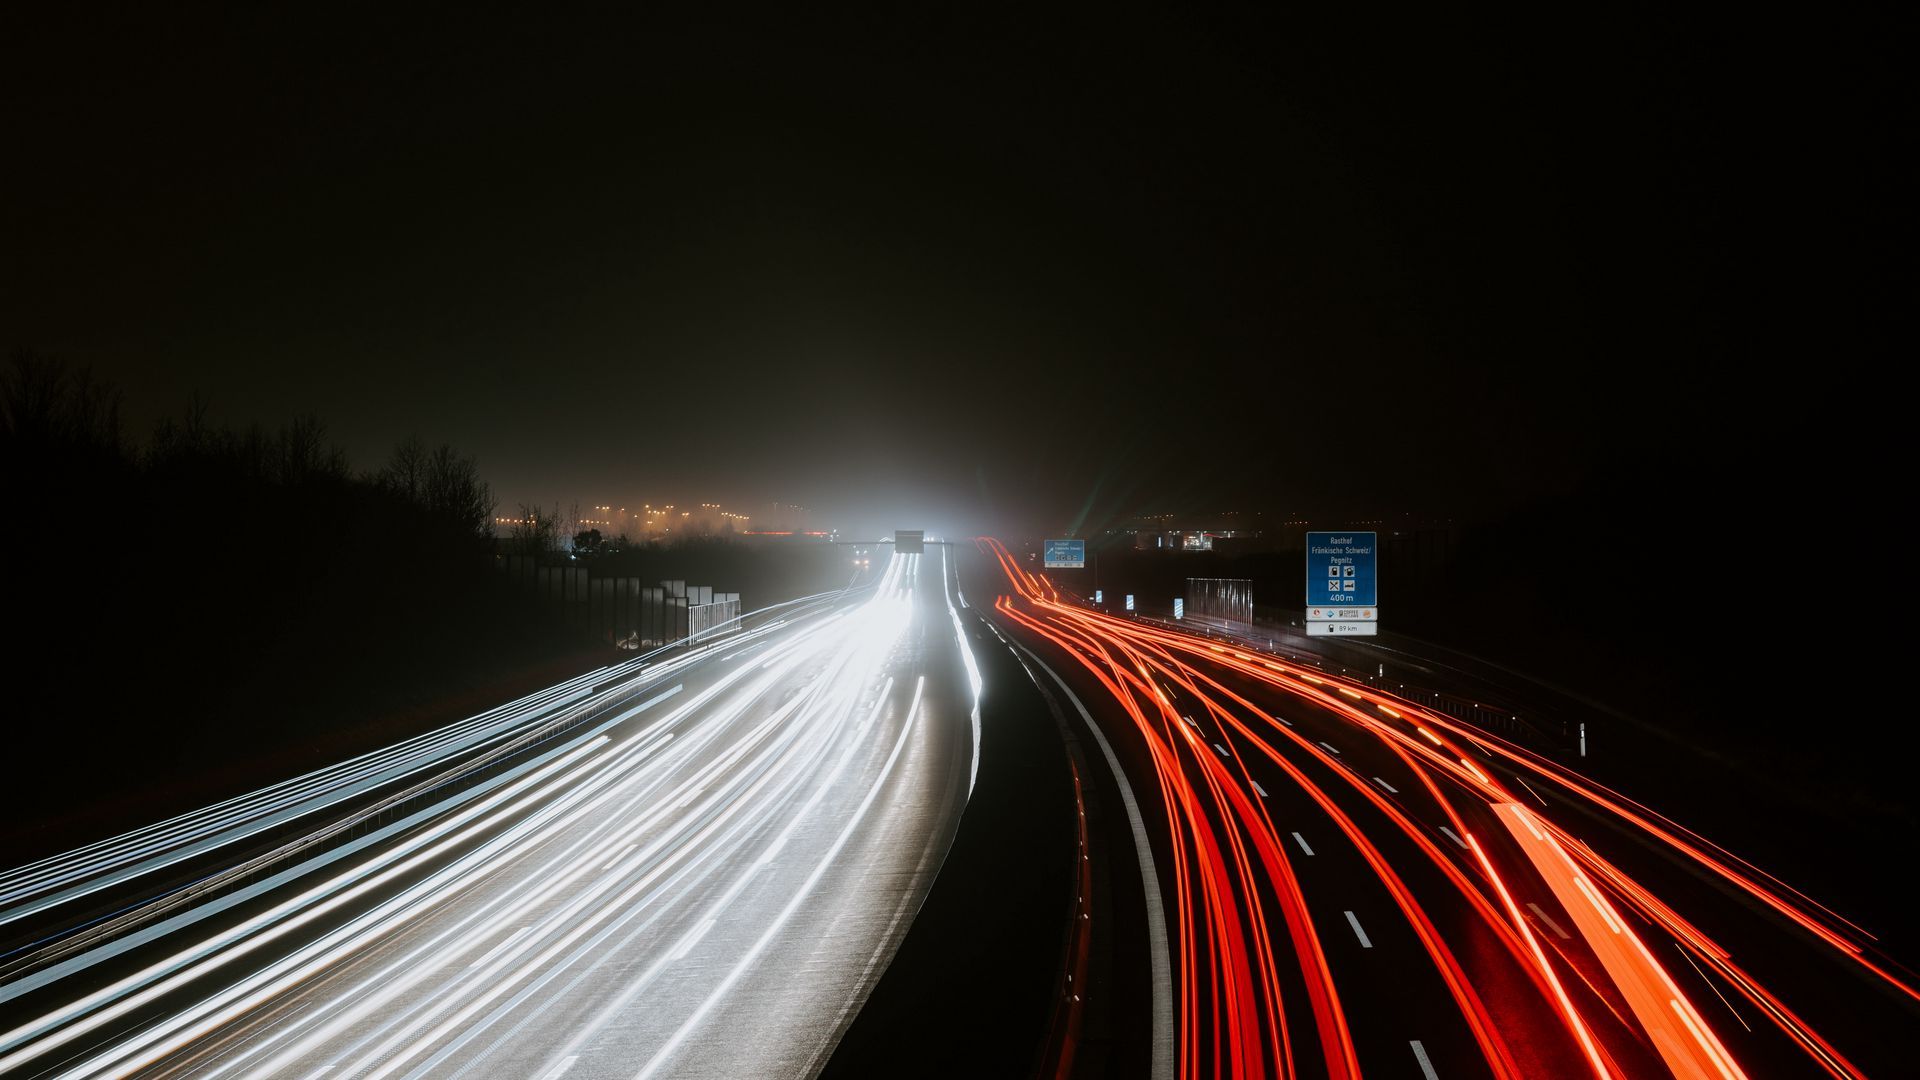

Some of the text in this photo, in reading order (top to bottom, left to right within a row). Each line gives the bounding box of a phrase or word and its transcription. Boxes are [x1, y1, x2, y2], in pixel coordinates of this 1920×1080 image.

[1311, 546, 1343, 554] Fränkische
[1330, 556, 1353, 565] Pegnitz
[1330, 594, 1345, 602] 400
